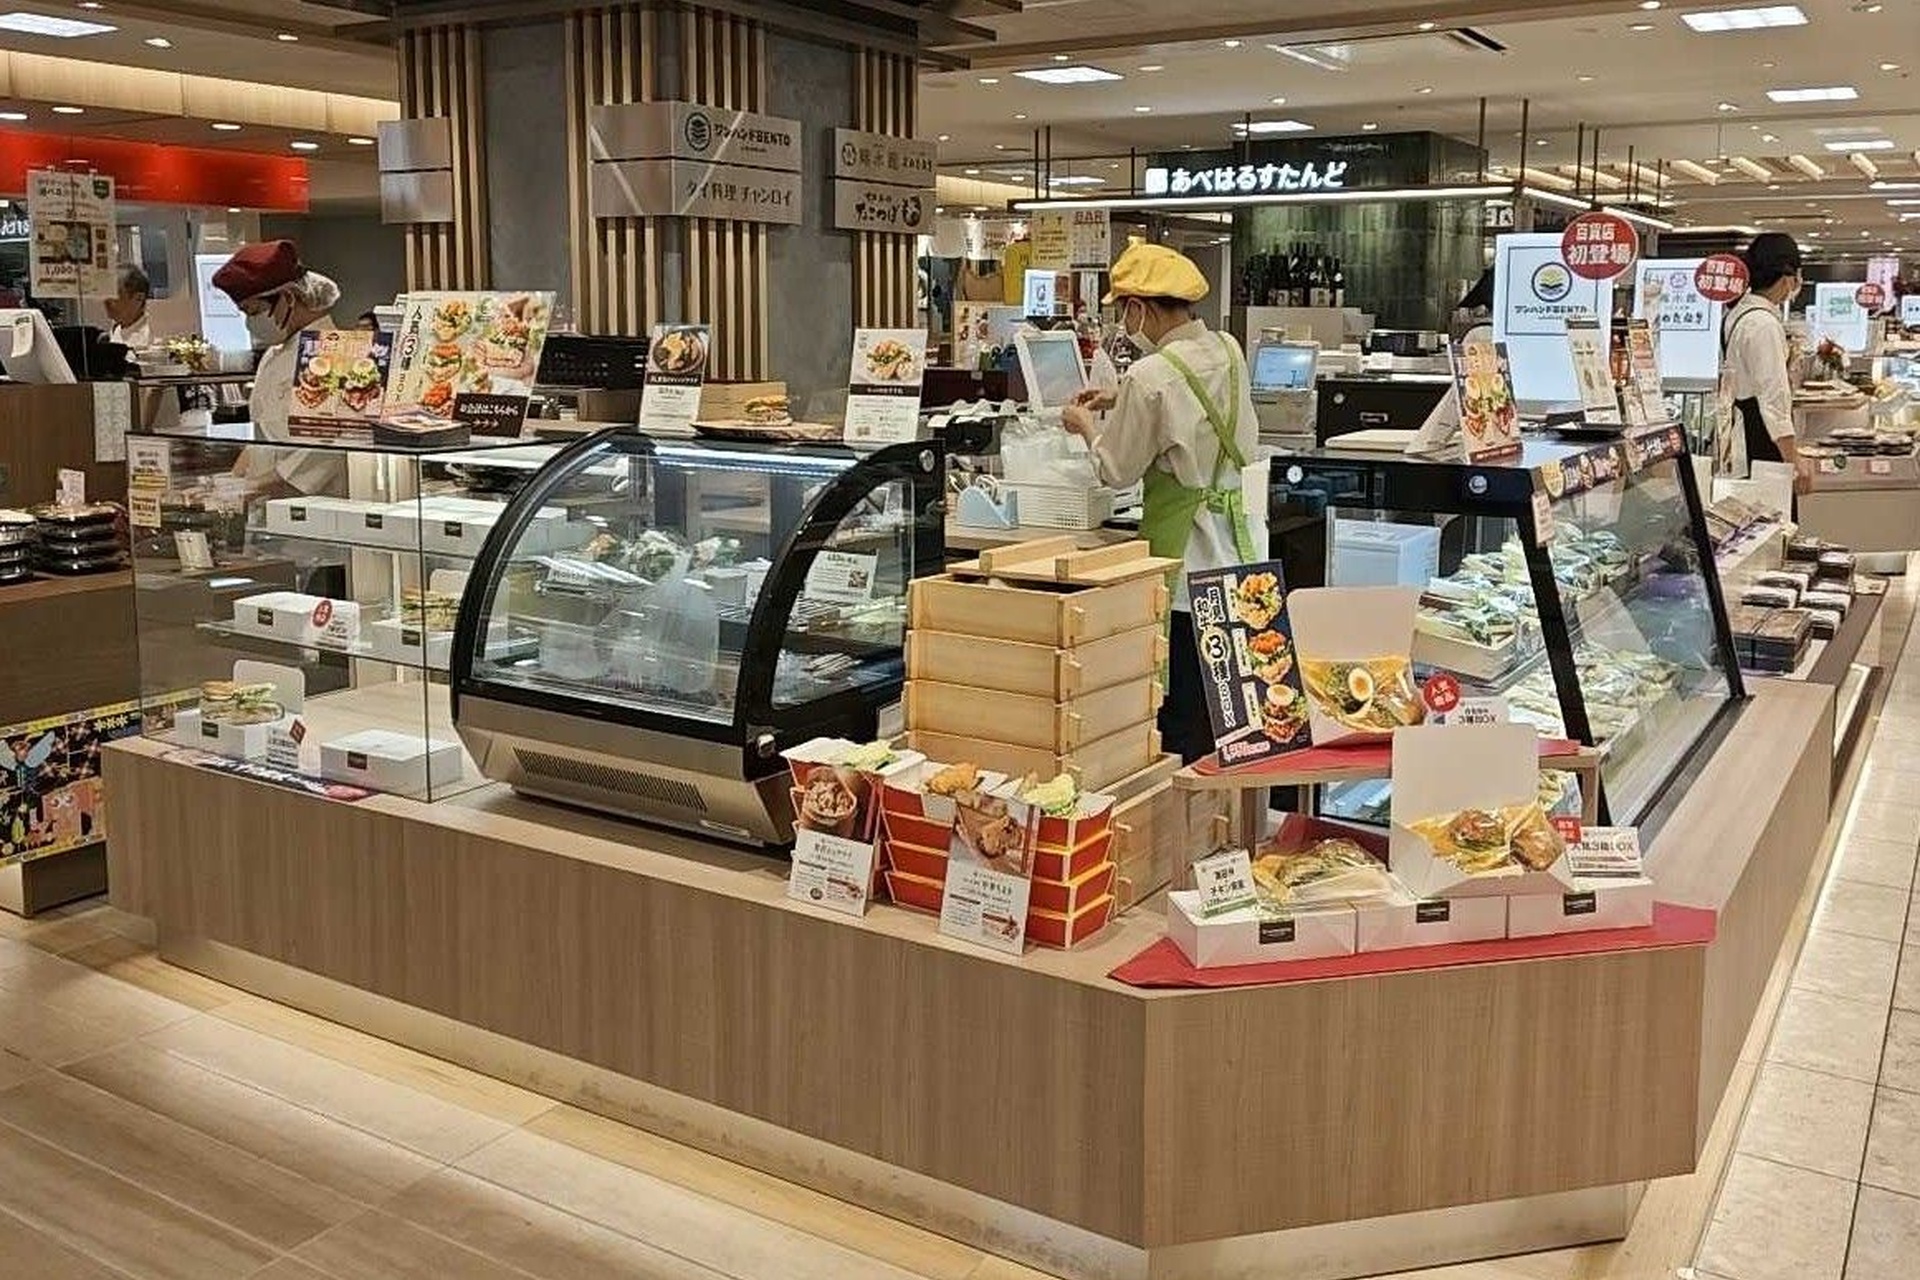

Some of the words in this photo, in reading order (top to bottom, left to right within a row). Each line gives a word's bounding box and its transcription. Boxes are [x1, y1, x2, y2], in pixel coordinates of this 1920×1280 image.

[1170, 161, 1348, 193] あべはるすたんど
[1575, 223, 1616, 242] 百貨店
[1567, 242, 1631, 266] 初登場
